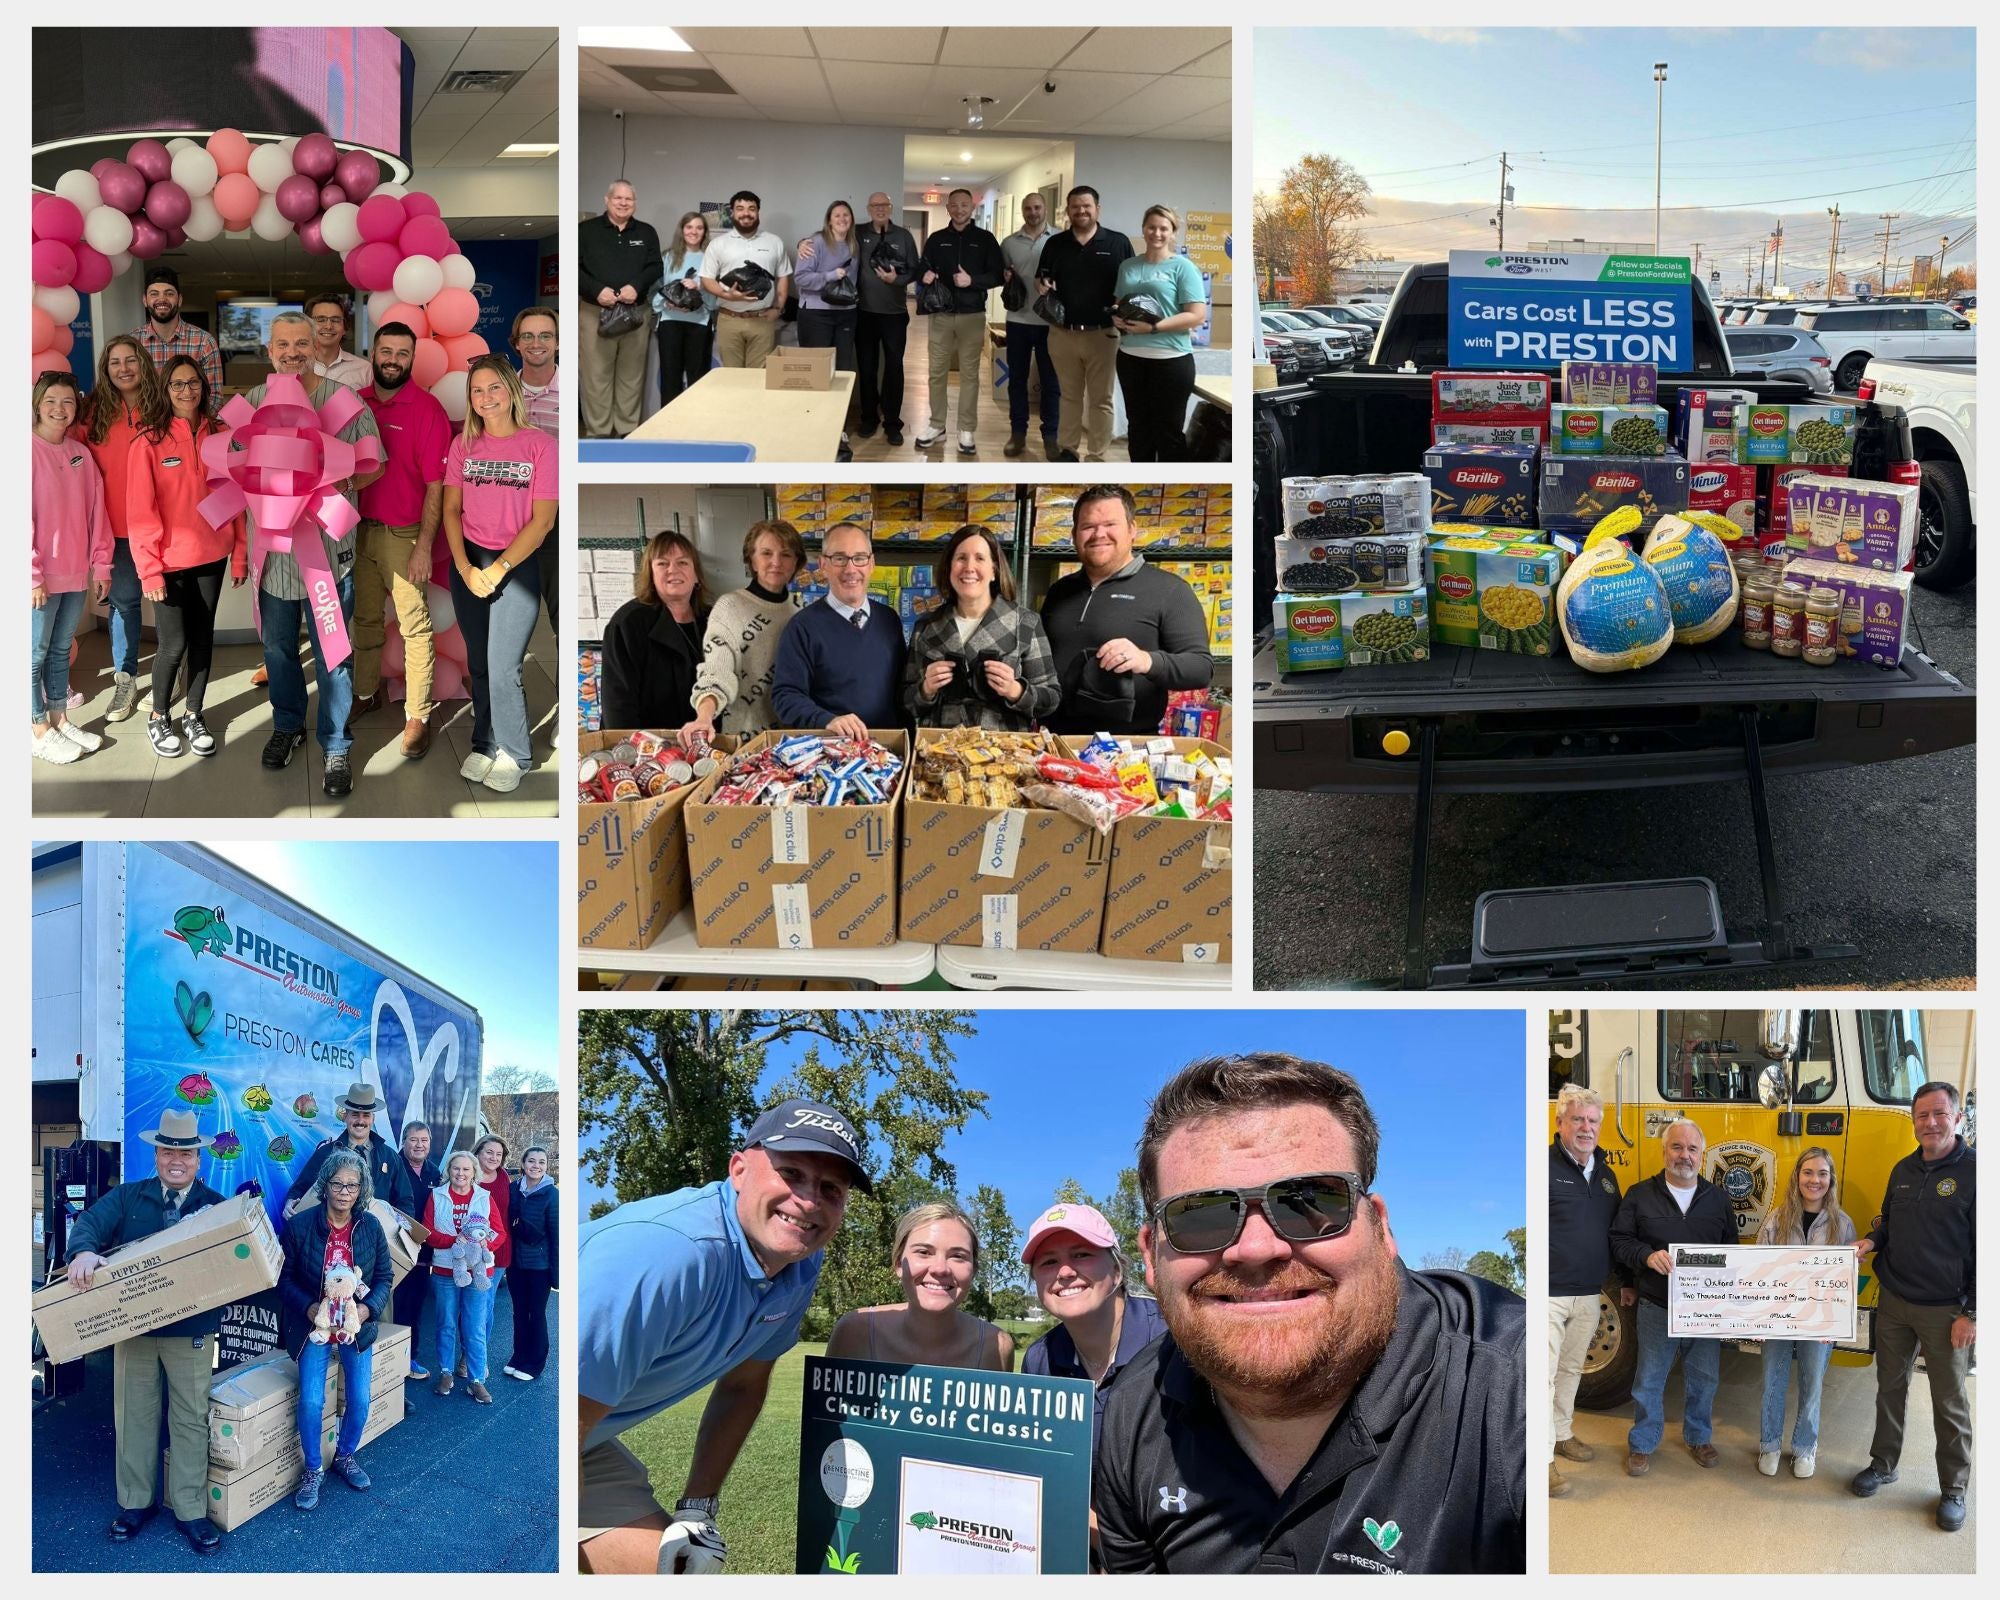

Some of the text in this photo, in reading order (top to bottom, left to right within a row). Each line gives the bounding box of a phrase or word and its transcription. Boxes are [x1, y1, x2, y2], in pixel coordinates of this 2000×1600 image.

[1187, 214, 1213, 222] Could
[1187, 223, 1206, 231] YOU
[1185, 233, 1217, 242] get the
[1186, 242, 1225, 251] nutrition
[1505, 255, 1569, 266] PRESTON
[1611, 260, 1639, 269] Follow
[1653, 261, 1683, 270] Socials
[1508, 265, 1530, 274] Ford
[1607, 269, 1687, 279] @ PrestonFordWest
[1463, 298, 1677, 328] Cars Cost LESS
[1463, 330, 1678, 362] with PRESTON
[1497, 382, 1523, 393] Juicy
[1694, 394, 1701, 404] 6
[1658, 415, 1665, 423] 8
[1833, 410, 1840, 418] 8
[1765, 418, 1784, 426] Monte
[1490, 429, 1517, 440] Juicy
[1519, 459, 1530, 474] 6
[1675, 466, 1685, 480] 6
[1456, 471, 1500, 484] Barilla
[1595, 476, 1638, 488] Barilla
[1690, 474, 1728, 489] Minute
[1354, 495, 1381, 505] GOYA
[1723, 489, 1730, 498] 8
[1866, 521, 1897, 533] Annie's
[1354, 543, 1382, 553] GOYA
[1866, 538, 1894, 548] VARIETY
[1385, 547, 1407, 555] GOYA
[1650, 544, 1683, 560] BUTTERBALL
[1519, 564, 1532, 575] 12
[1592, 561, 1633, 574] BUTTERBALL
[1657, 561, 1695, 577] emium
[1440, 580, 1472, 590] Del Monte
[1590, 575, 1648, 596] Premium
[1399, 600, 1407, 610] 8
[1295, 614, 1335, 625] Del Monte
[1865, 615, 1898, 628] Annie's
[740, 613, 772, 654] LOVE
[1865, 632, 1896, 642] VARIETY
[1293, 645, 1319, 654] SWEET
[1321, 644, 1340, 652] PEAS
[922, 809, 948, 832] sam's
[1133, 819, 1162, 842] sam's
[785, 839, 796, 862] club
[994, 832, 1008, 855] club
[1182, 870, 1211, 895] sam's
[811, 896, 836, 920] sam's
[832, 879, 851, 901] club
[703, 889, 741, 927] sam's club
[906, 895, 949, 932] sam's club
[1016, 894, 1061, 931] sam's club
[1110, 907, 1158, 941] sam's club
[236, 925, 340, 997] PRESTON
[283, 972, 335, 1007] Automotive
[225, 1012, 355, 1070] PRESTON CARES
[1727, 1156, 1752, 1165] OXFORD
[110, 1255, 162, 1280] PUPPY 2023
[1705, 1278, 1734, 1288] Oxford
[1739, 1279, 1752, 1287] Fire
[1772, 1280, 1788, 1288] Inc
[129, 1321, 152, 1333] Country
[176, 1303, 198, 1316] CHINA
[221, 1304, 279, 1333] DEJANA
[220, 1324, 279, 1344] TRUCK EQUIPMENT
[226, 1336, 272, 1353] MID-ATLANTIC
[813, 1366, 1085, 1422] BENEDICTINE FOUNDATION
[825, 1396, 1053, 1443] Charity Golf Classic
[827, 1465, 870, 1479] BENEDICTINE
[939, 1516, 1013, 1541] PRESTON
[940, 1534, 1011, 1554] PRESTONMOTOR.COM
[967, 1530, 1036, 1553] Automotive Group
[1349, 1554, 1395, 1575] PRESTON
